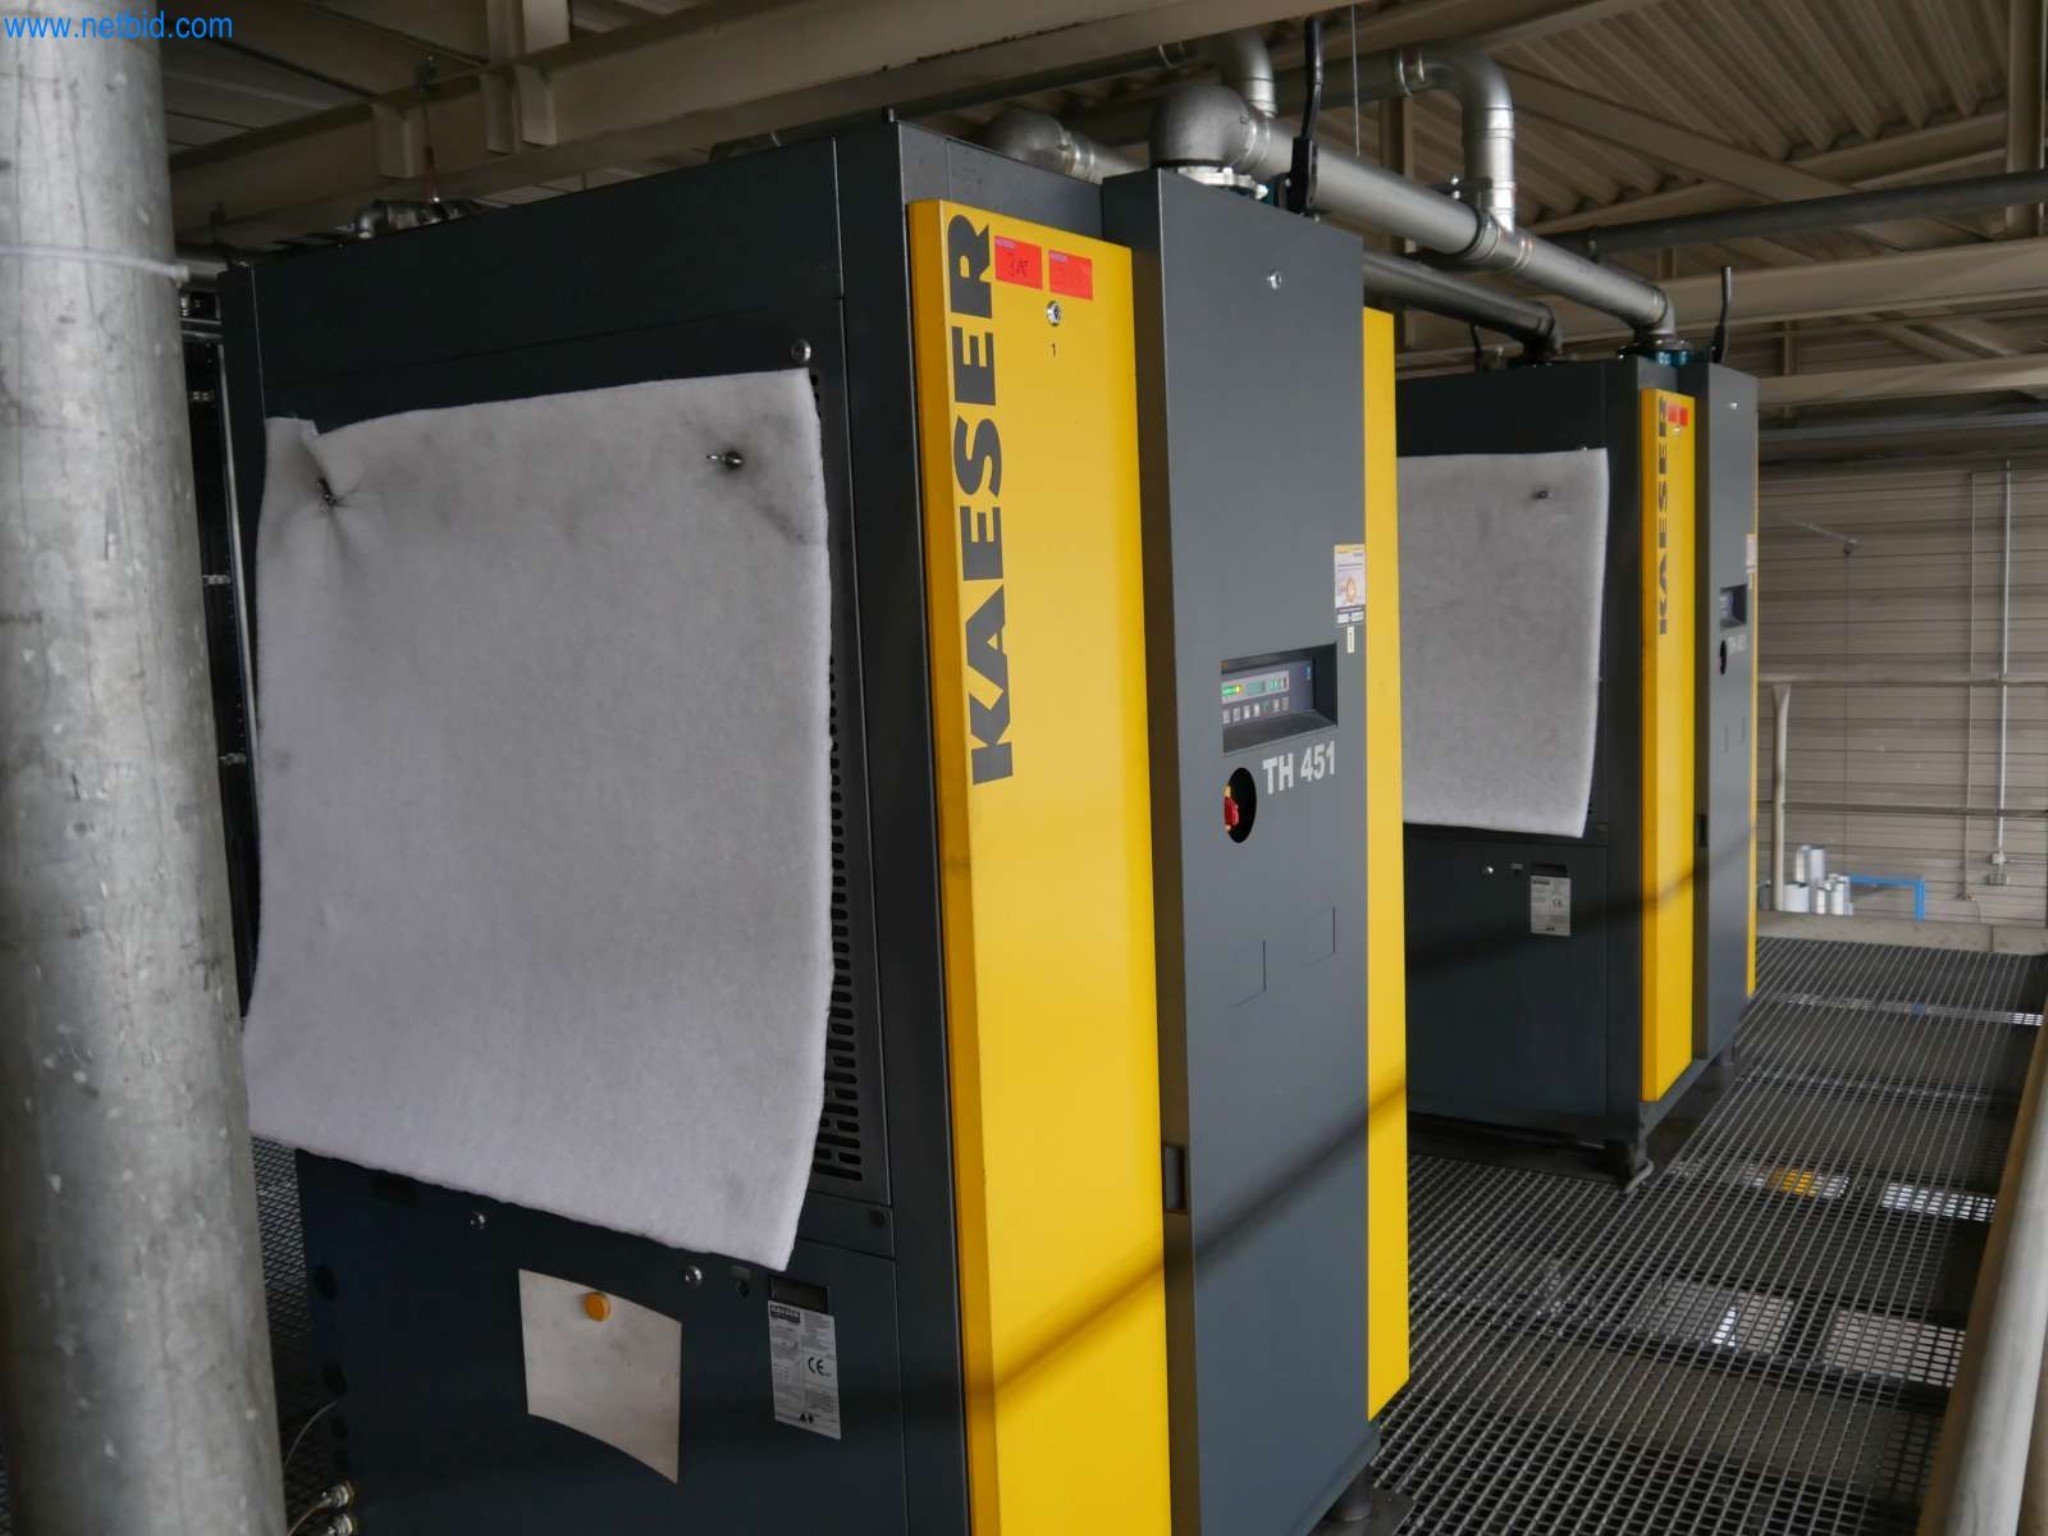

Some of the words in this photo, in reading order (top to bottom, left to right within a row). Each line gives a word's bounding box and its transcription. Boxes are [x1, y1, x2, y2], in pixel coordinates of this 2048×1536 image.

[946, 214, 1014, 785] KAESER
[1658, 397, 1668, 634] KAESER
[1262, 752, 1294, 795] TH
[1300, 740, 1336, 782] 451
